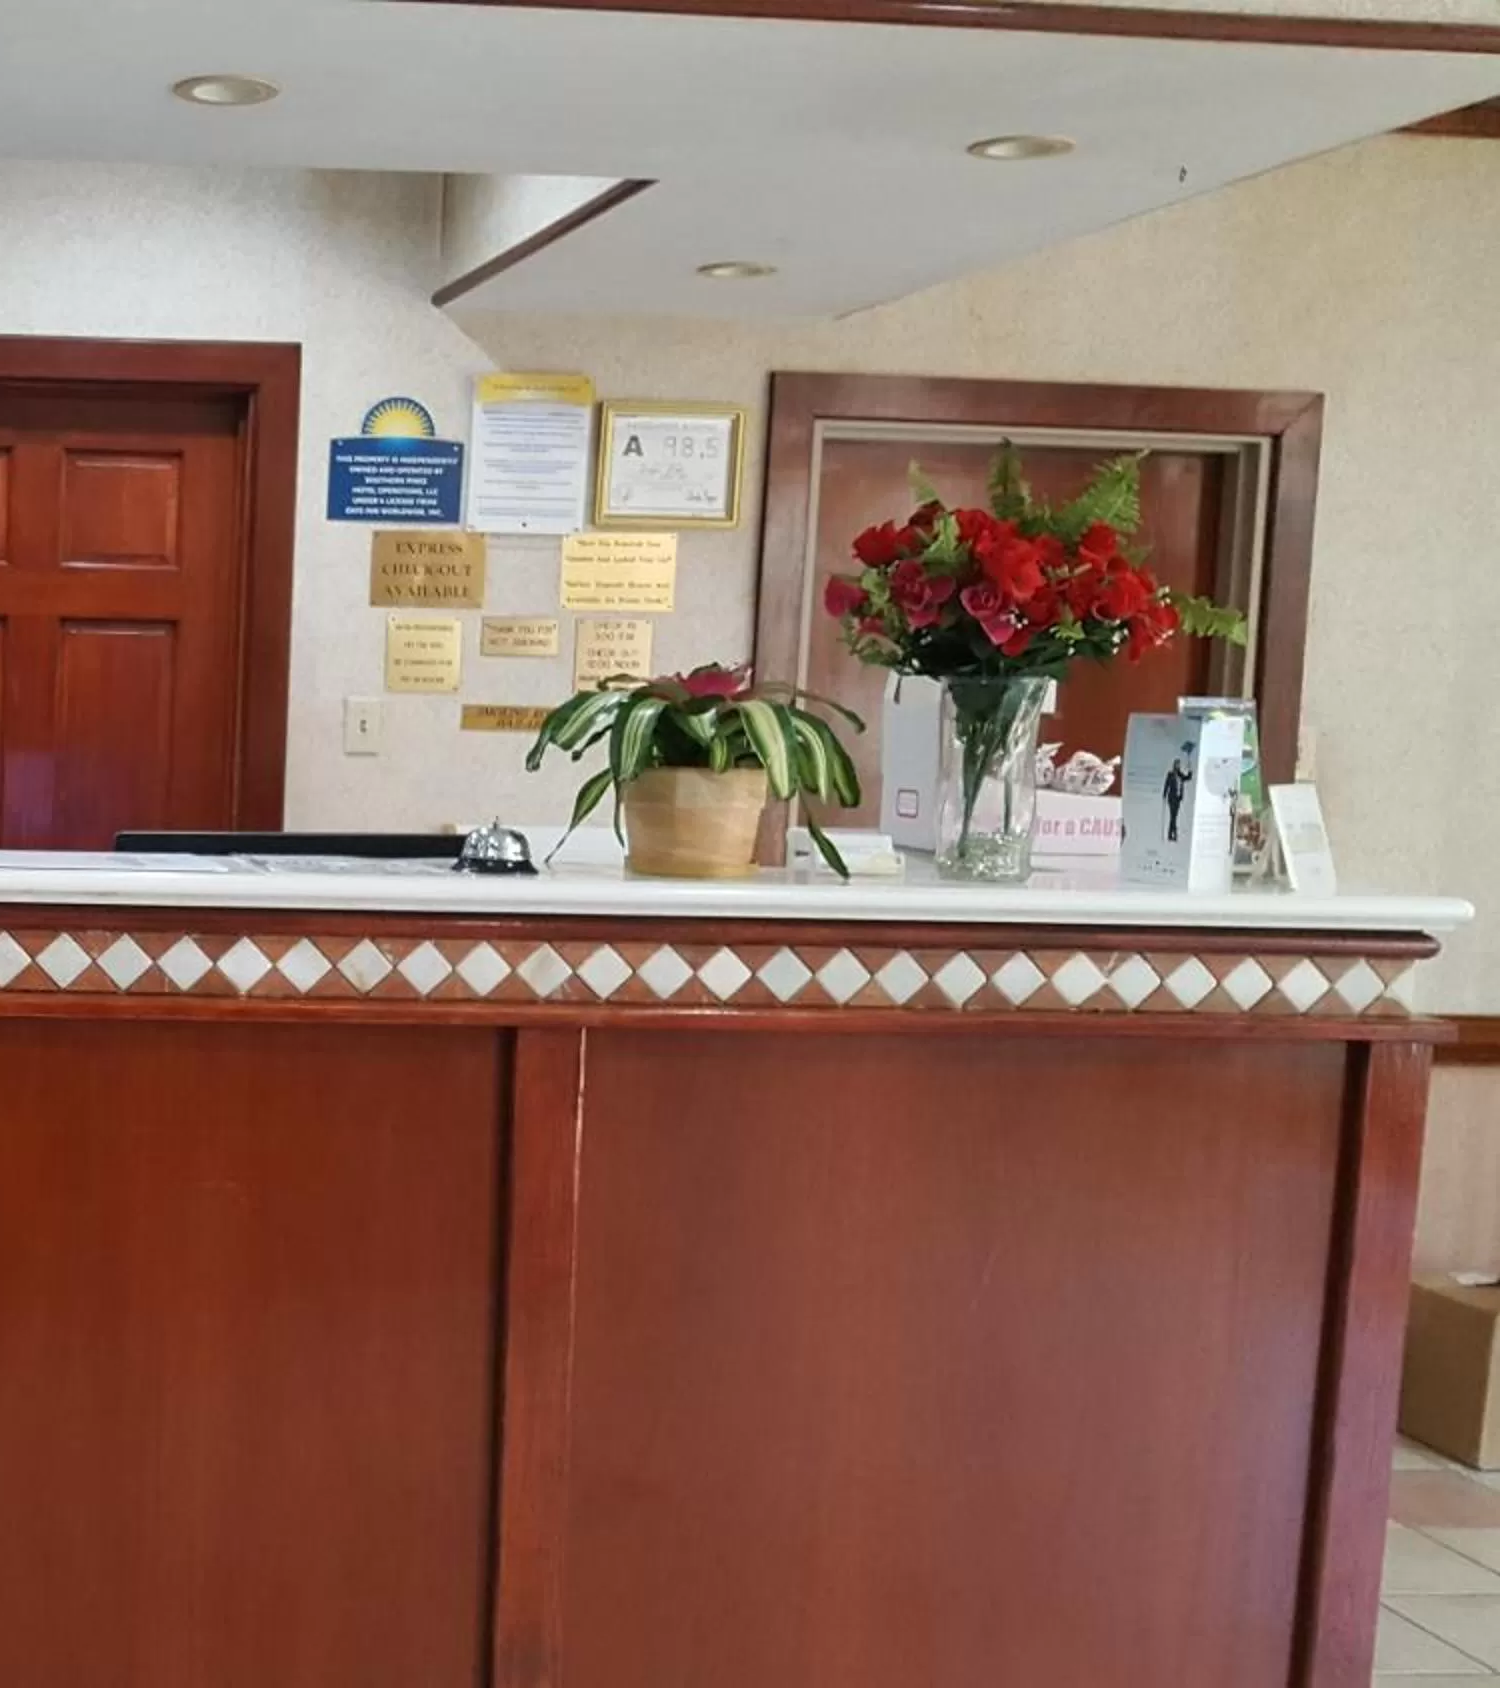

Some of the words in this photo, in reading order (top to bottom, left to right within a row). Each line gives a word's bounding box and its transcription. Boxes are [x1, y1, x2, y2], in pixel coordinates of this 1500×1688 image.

[622, 434, 644, 456] A
[662, 435, 719, 459] 98.5
[395, 542, 463, 554] EXPRESS
[384, 584, 471, 600] AVAILABLE
